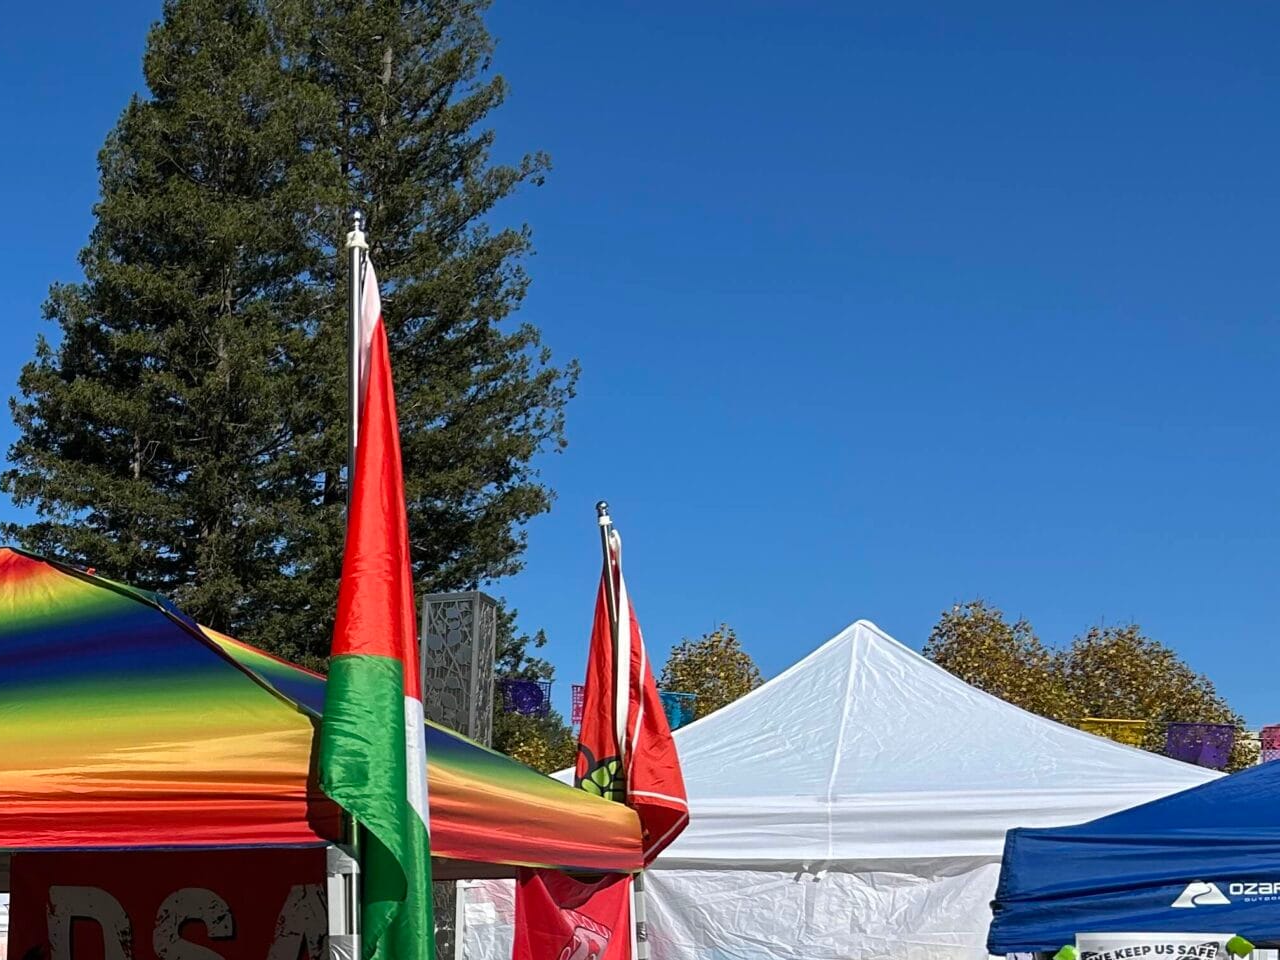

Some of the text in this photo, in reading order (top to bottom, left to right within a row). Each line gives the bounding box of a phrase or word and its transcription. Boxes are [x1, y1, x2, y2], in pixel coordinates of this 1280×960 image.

[1115, 946, 1151, 959] KEEP
[1155, 945, 1174, 955] US
[1177, 945, 1215, 959] SAFE
